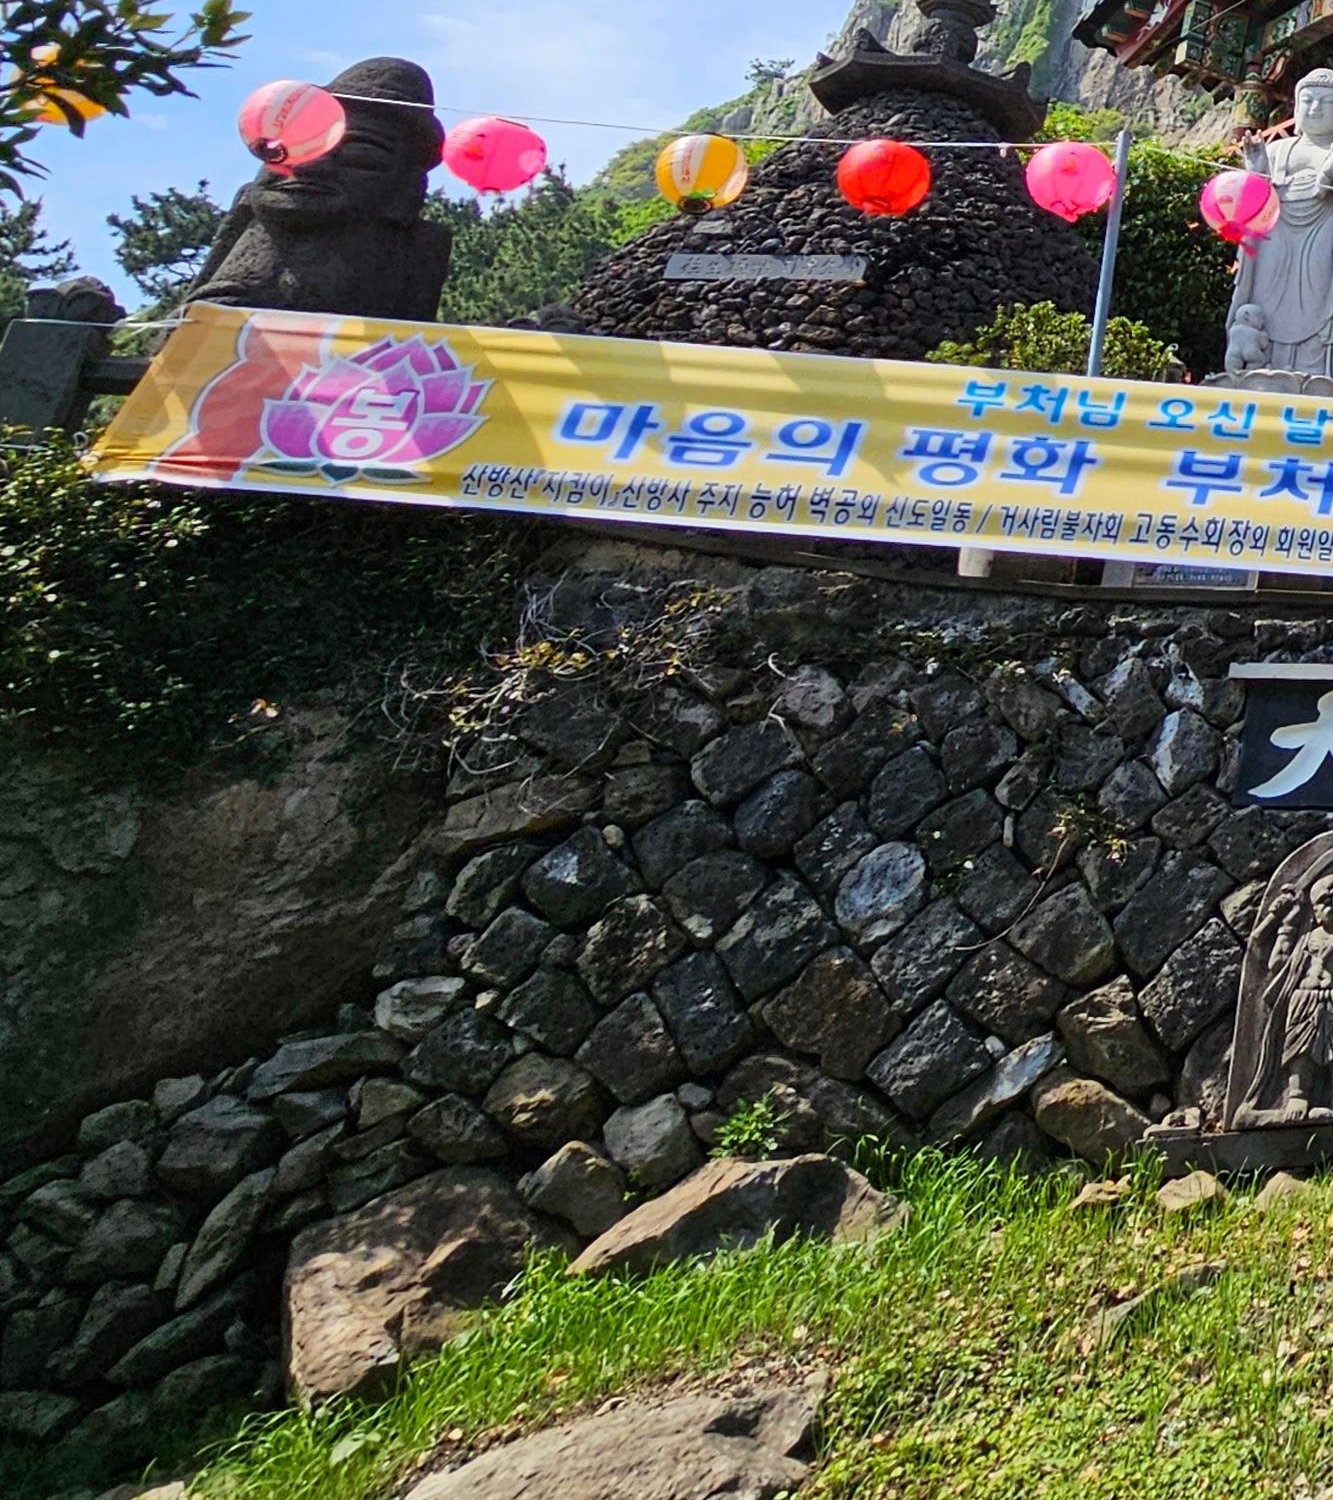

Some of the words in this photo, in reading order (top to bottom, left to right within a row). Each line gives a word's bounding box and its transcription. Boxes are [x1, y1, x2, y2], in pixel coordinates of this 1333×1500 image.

[330, 388, 417, 458] 봉
[957, 380, 1127, 428] 부처님
[1148, 398, 1257, 439] 오신
[1281, 405, 1333, 445] 날
[560, 403, 863, 476] 마음의
[903, 428, 1097, 495] 평화
[696, 482, 743, 517] 주지
[749, 482, 802, 521] 능허
[885, 499, 972, 533] 신도일동
[999, 505, 1125, 545] 거사림불자회
